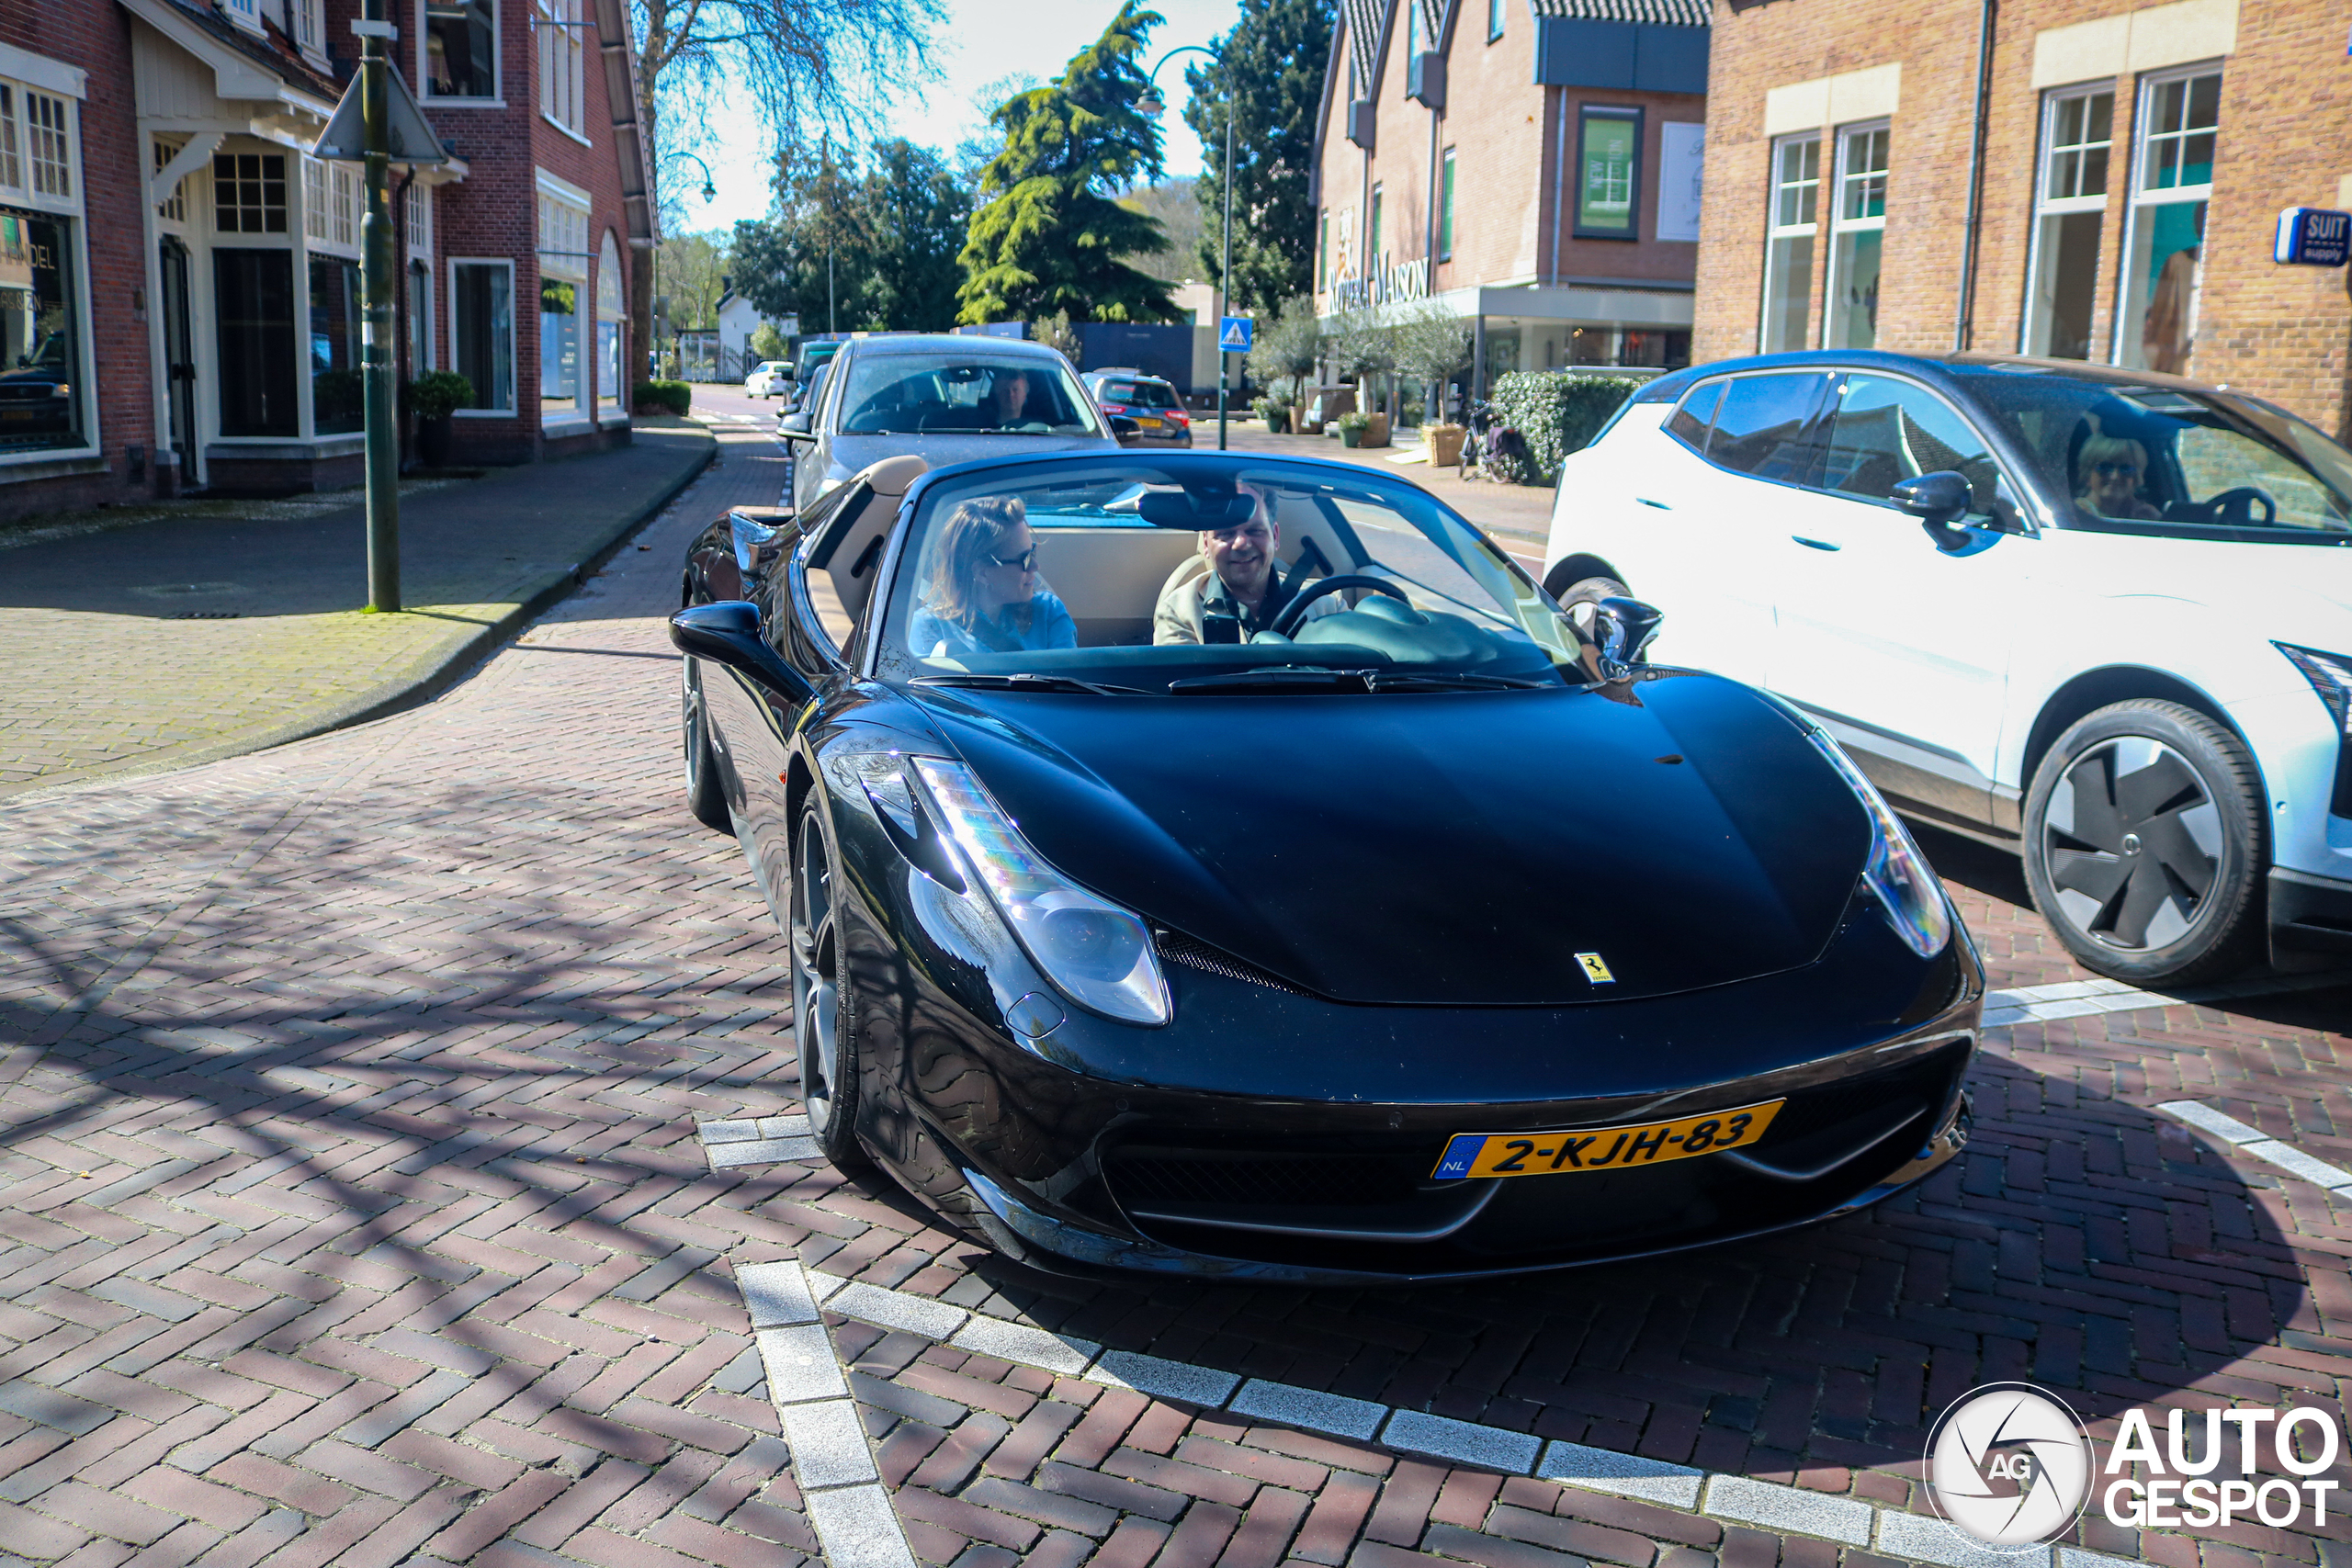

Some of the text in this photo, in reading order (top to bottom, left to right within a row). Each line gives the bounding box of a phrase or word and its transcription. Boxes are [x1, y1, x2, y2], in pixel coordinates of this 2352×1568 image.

[1589, 160, 1603, 189] NEW
[2308, 214, 2347, 239] SUIT
[2305, 247, 2343, 262] supply
[1374, 249, 1430, 305] MAISON
[1491, 1112, 1753, 1173] 2-KJH-83
[1442, 1161, 1465, 1171] NL
